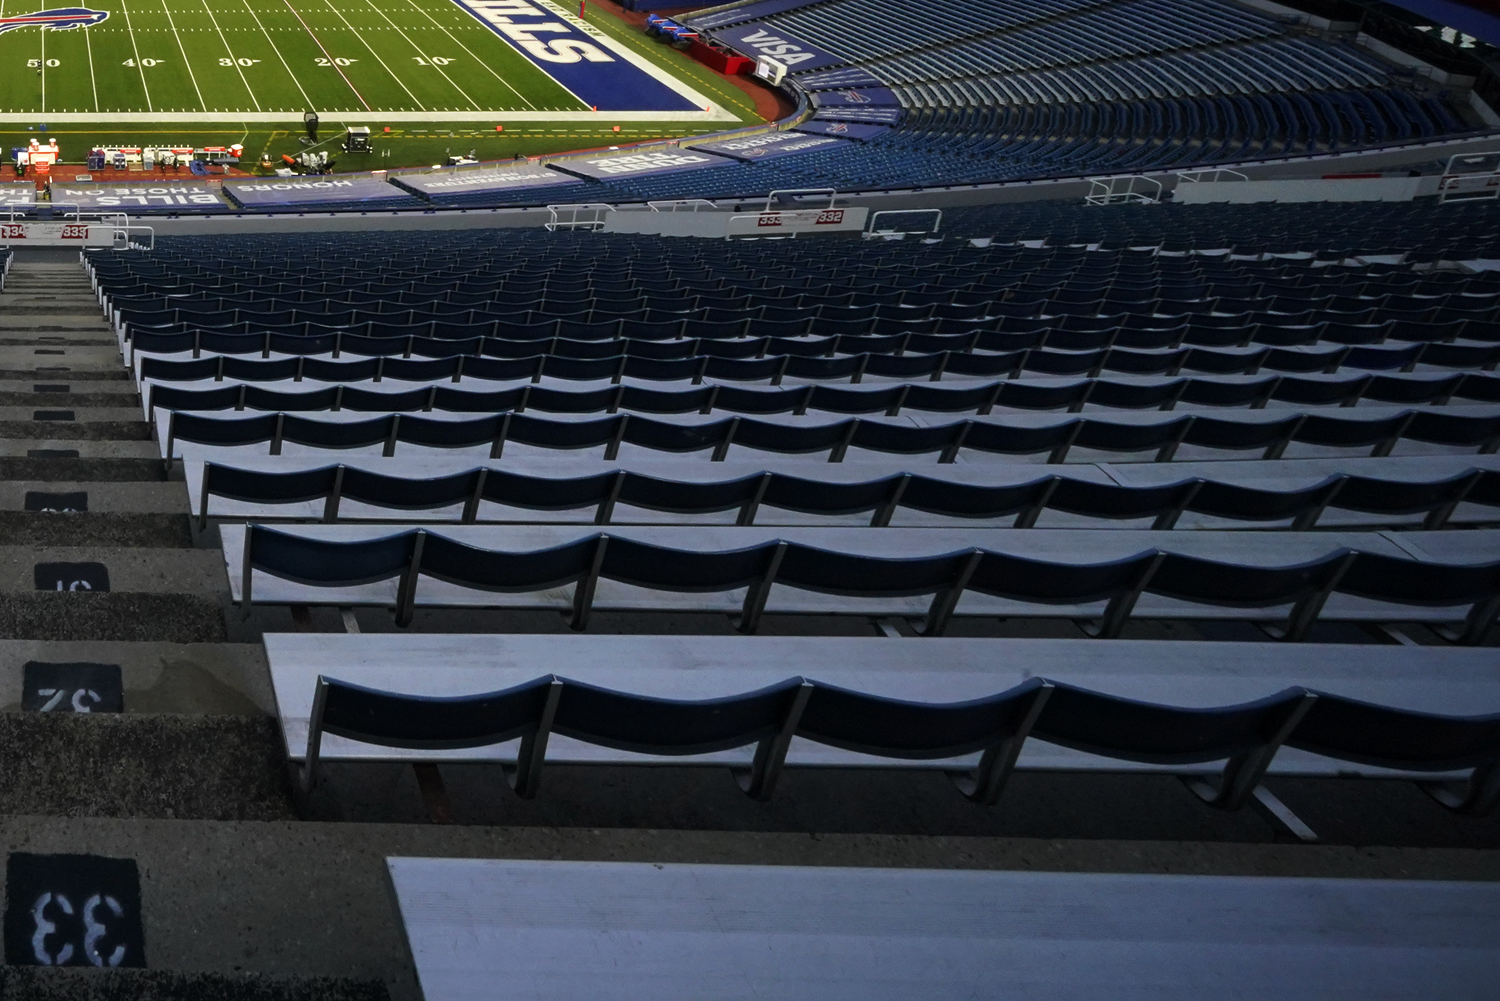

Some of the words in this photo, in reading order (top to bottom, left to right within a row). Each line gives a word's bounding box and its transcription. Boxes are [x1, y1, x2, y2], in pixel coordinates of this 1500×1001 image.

[740, 28, 816, 66] VISA
[587, 151, 680, 166] TIRE
[597, 154, 710, 174] DUNN
[236, 180, 354, 192] HONORS
[423, 173, 543, 188] BONAVENTURE
[96, 194, 220, 206] BILLS
[818, 211, 843, 223] 332
[32, 892, 125, 967] 33
